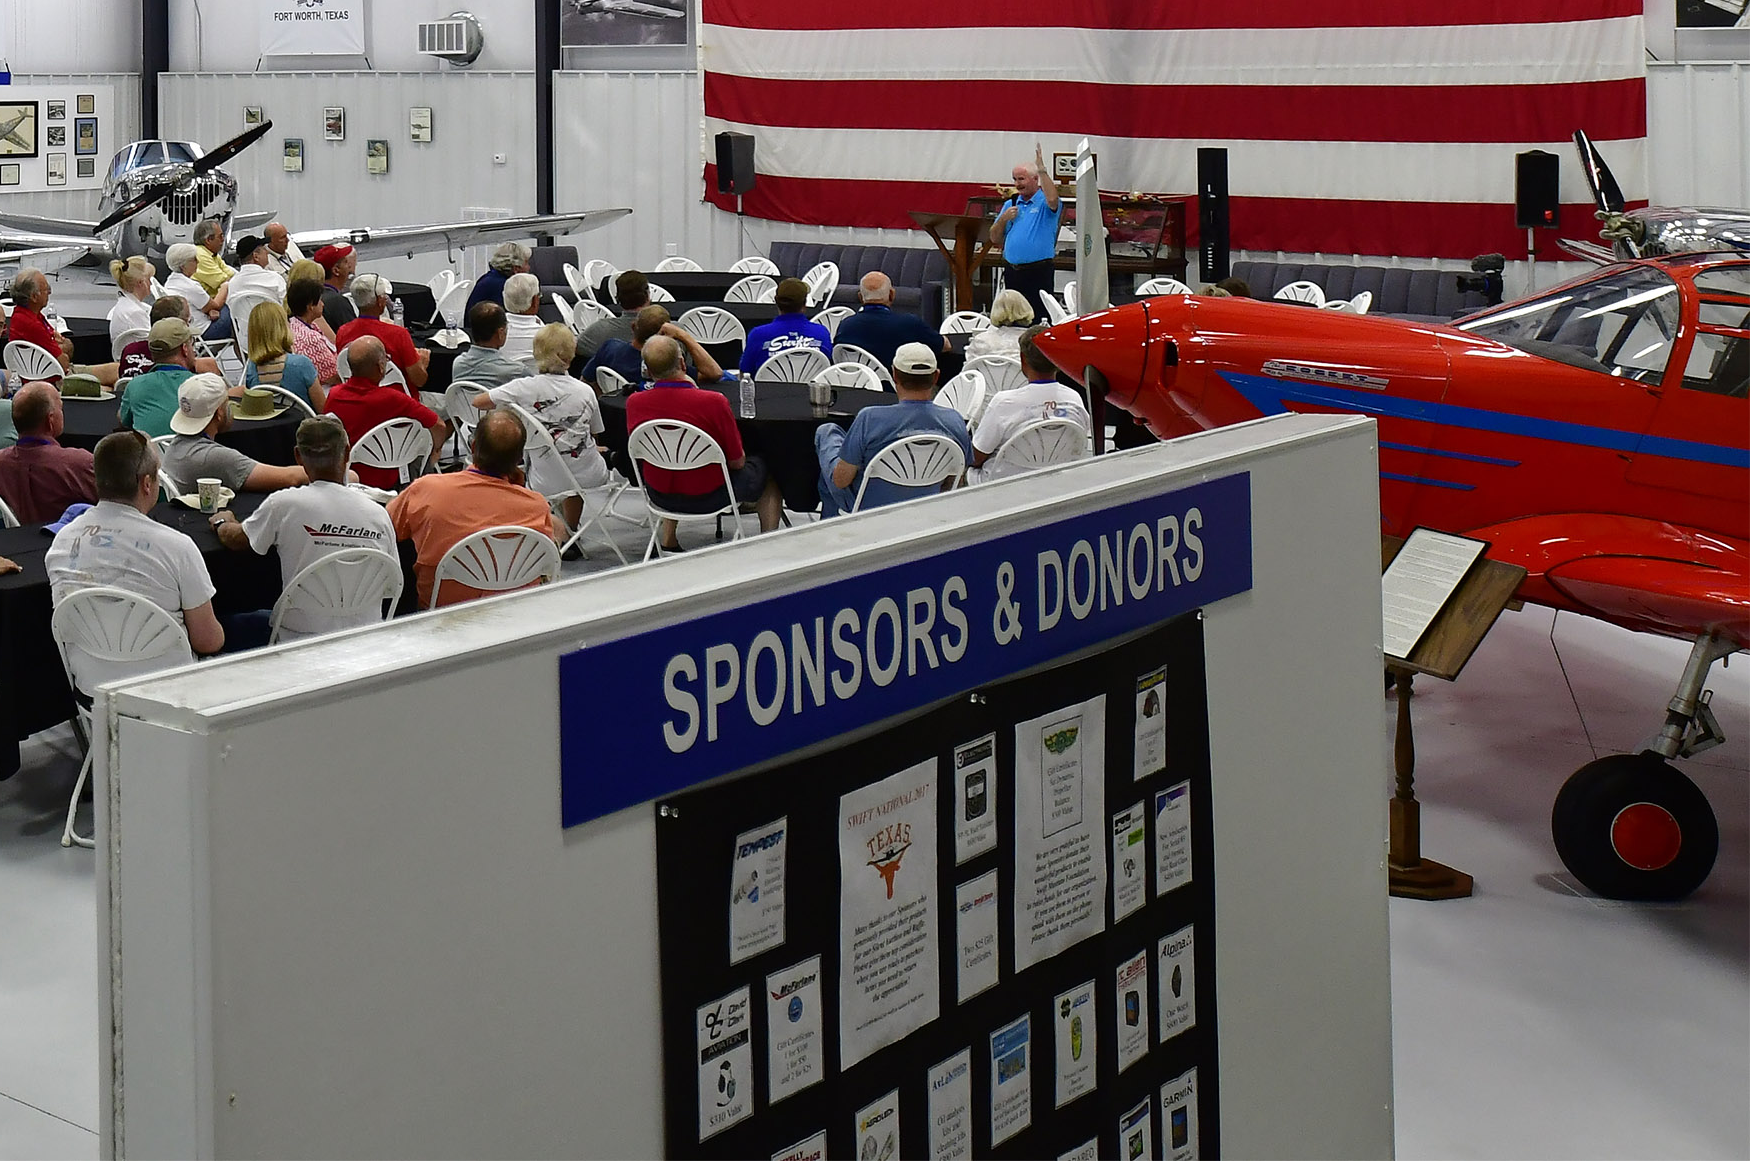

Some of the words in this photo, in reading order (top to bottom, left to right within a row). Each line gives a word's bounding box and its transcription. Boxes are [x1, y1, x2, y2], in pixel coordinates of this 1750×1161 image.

[274, 12, 293, 21] FORT
[294, 11, 324, 22] WORTH,
[325, 11, 349, 20] TEXAS
[82, 525, 101, 537] 70
[320, 523, 382, 540] McFarlane
[662, 576, 969, 753] SPONSORS
[993, 561, 1022, 645] &
[1038, 508, 1204, 632] DONORS
[847, 809, 873, 831] SWIFT
[875, 790, 912, 818] NATIONAL
[737, 829, 784, 860] TEMPEST
[867, 822, 911, 858] TEXAS
[780, 973, 816, 995] McFarlane
[728, 998, 747, 1015] David
[708, 1033, 742, 1056] AVIATION
[1163, 1084, 1193, 1108] GARMIN
[727, 1103, 743, 1118] Value
